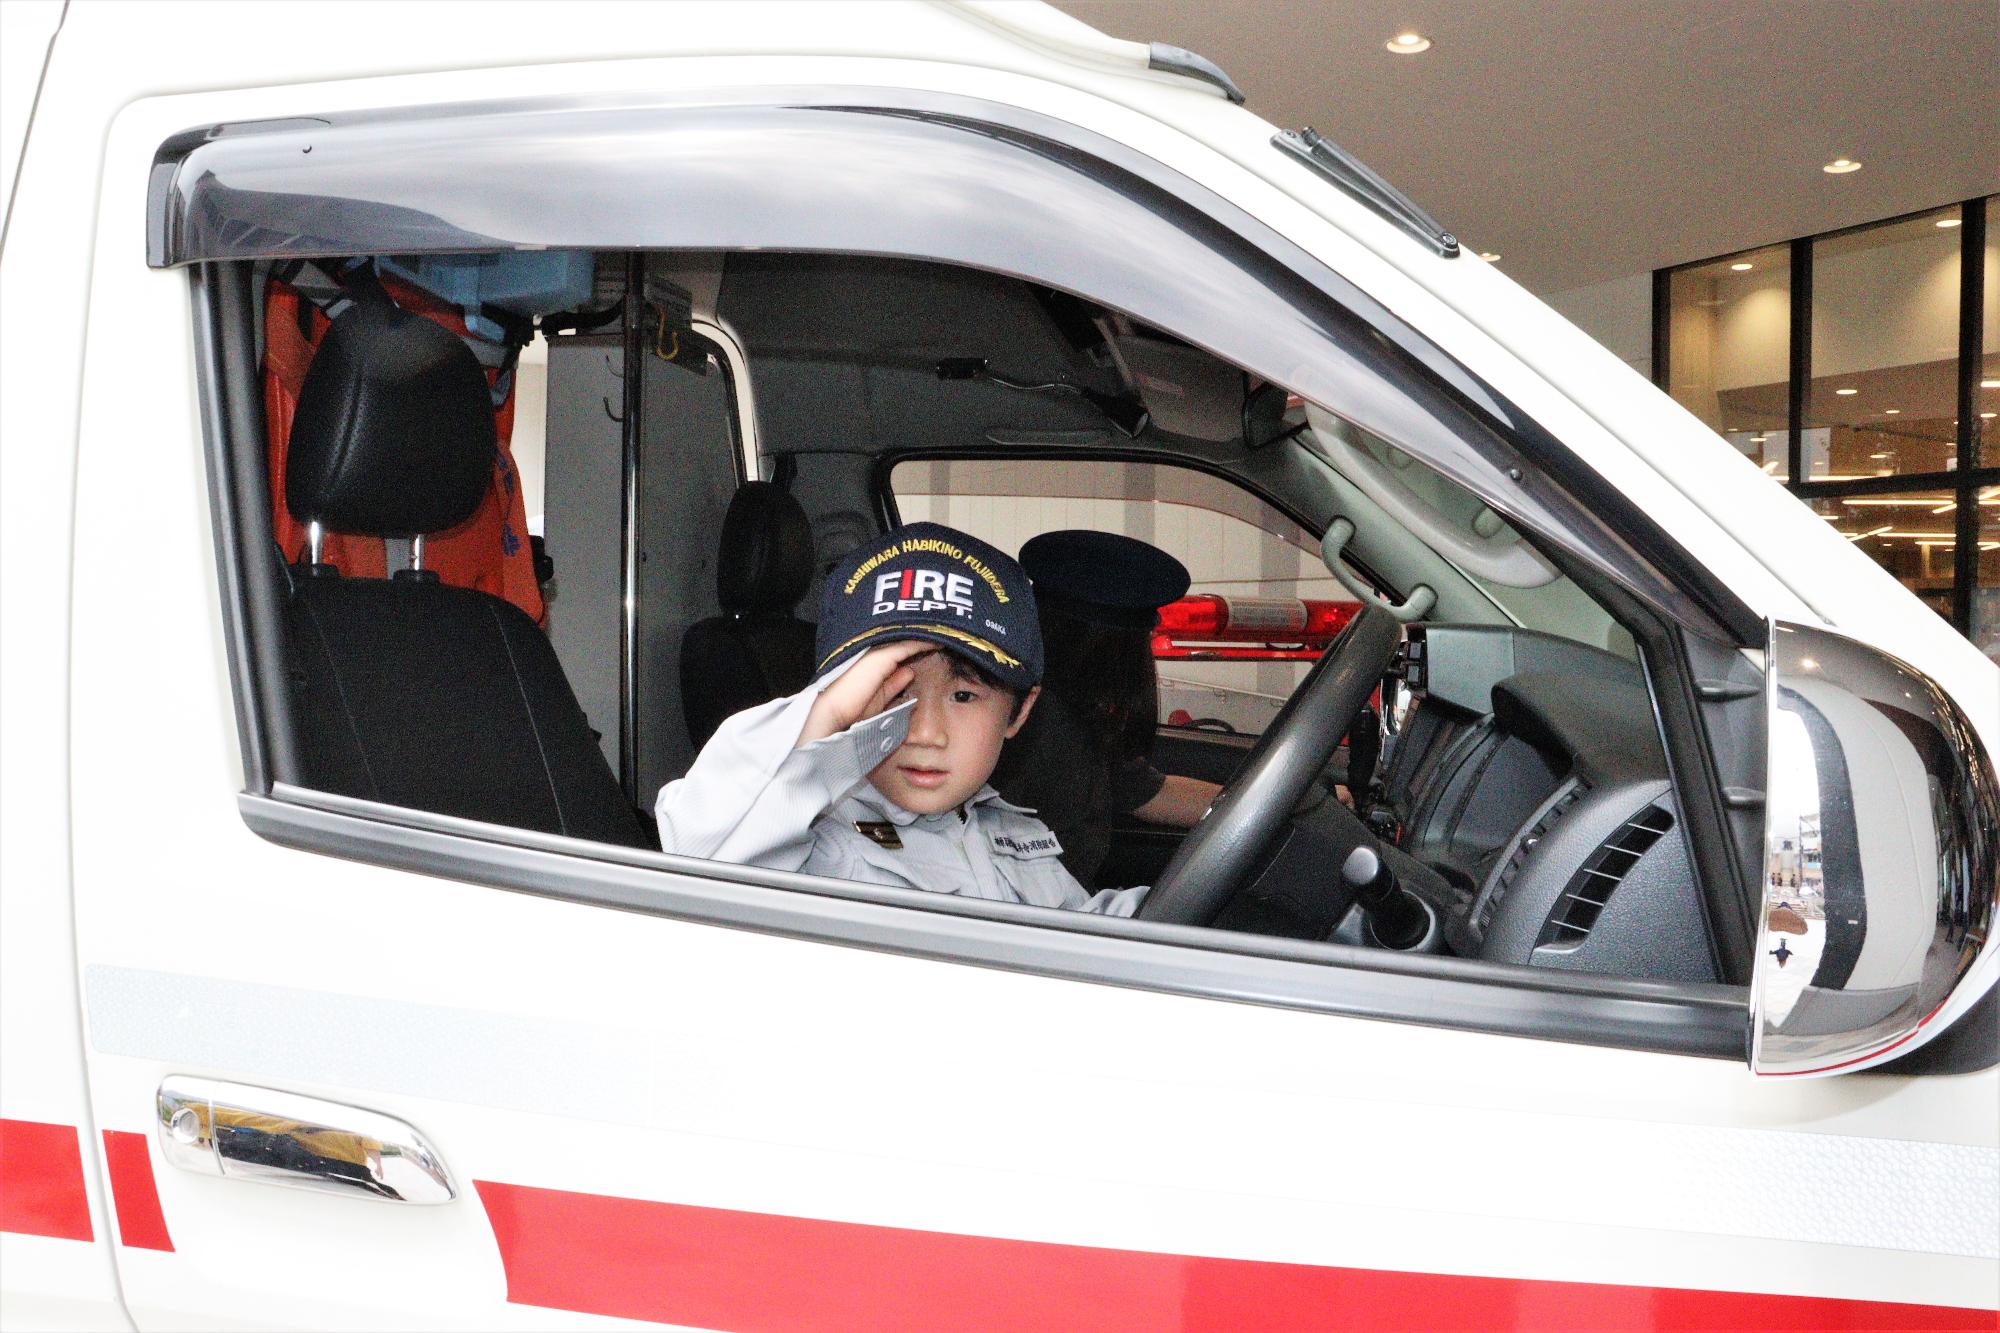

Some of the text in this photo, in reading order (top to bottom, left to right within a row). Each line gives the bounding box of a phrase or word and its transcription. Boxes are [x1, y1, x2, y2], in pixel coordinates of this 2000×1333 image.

[844, 539, 1010, 603] KASHIWARA HABIKINO FUJIIDERA
[874, 569, 973, 607] FIRE
[872, 599, 973, 619] DEPT.
